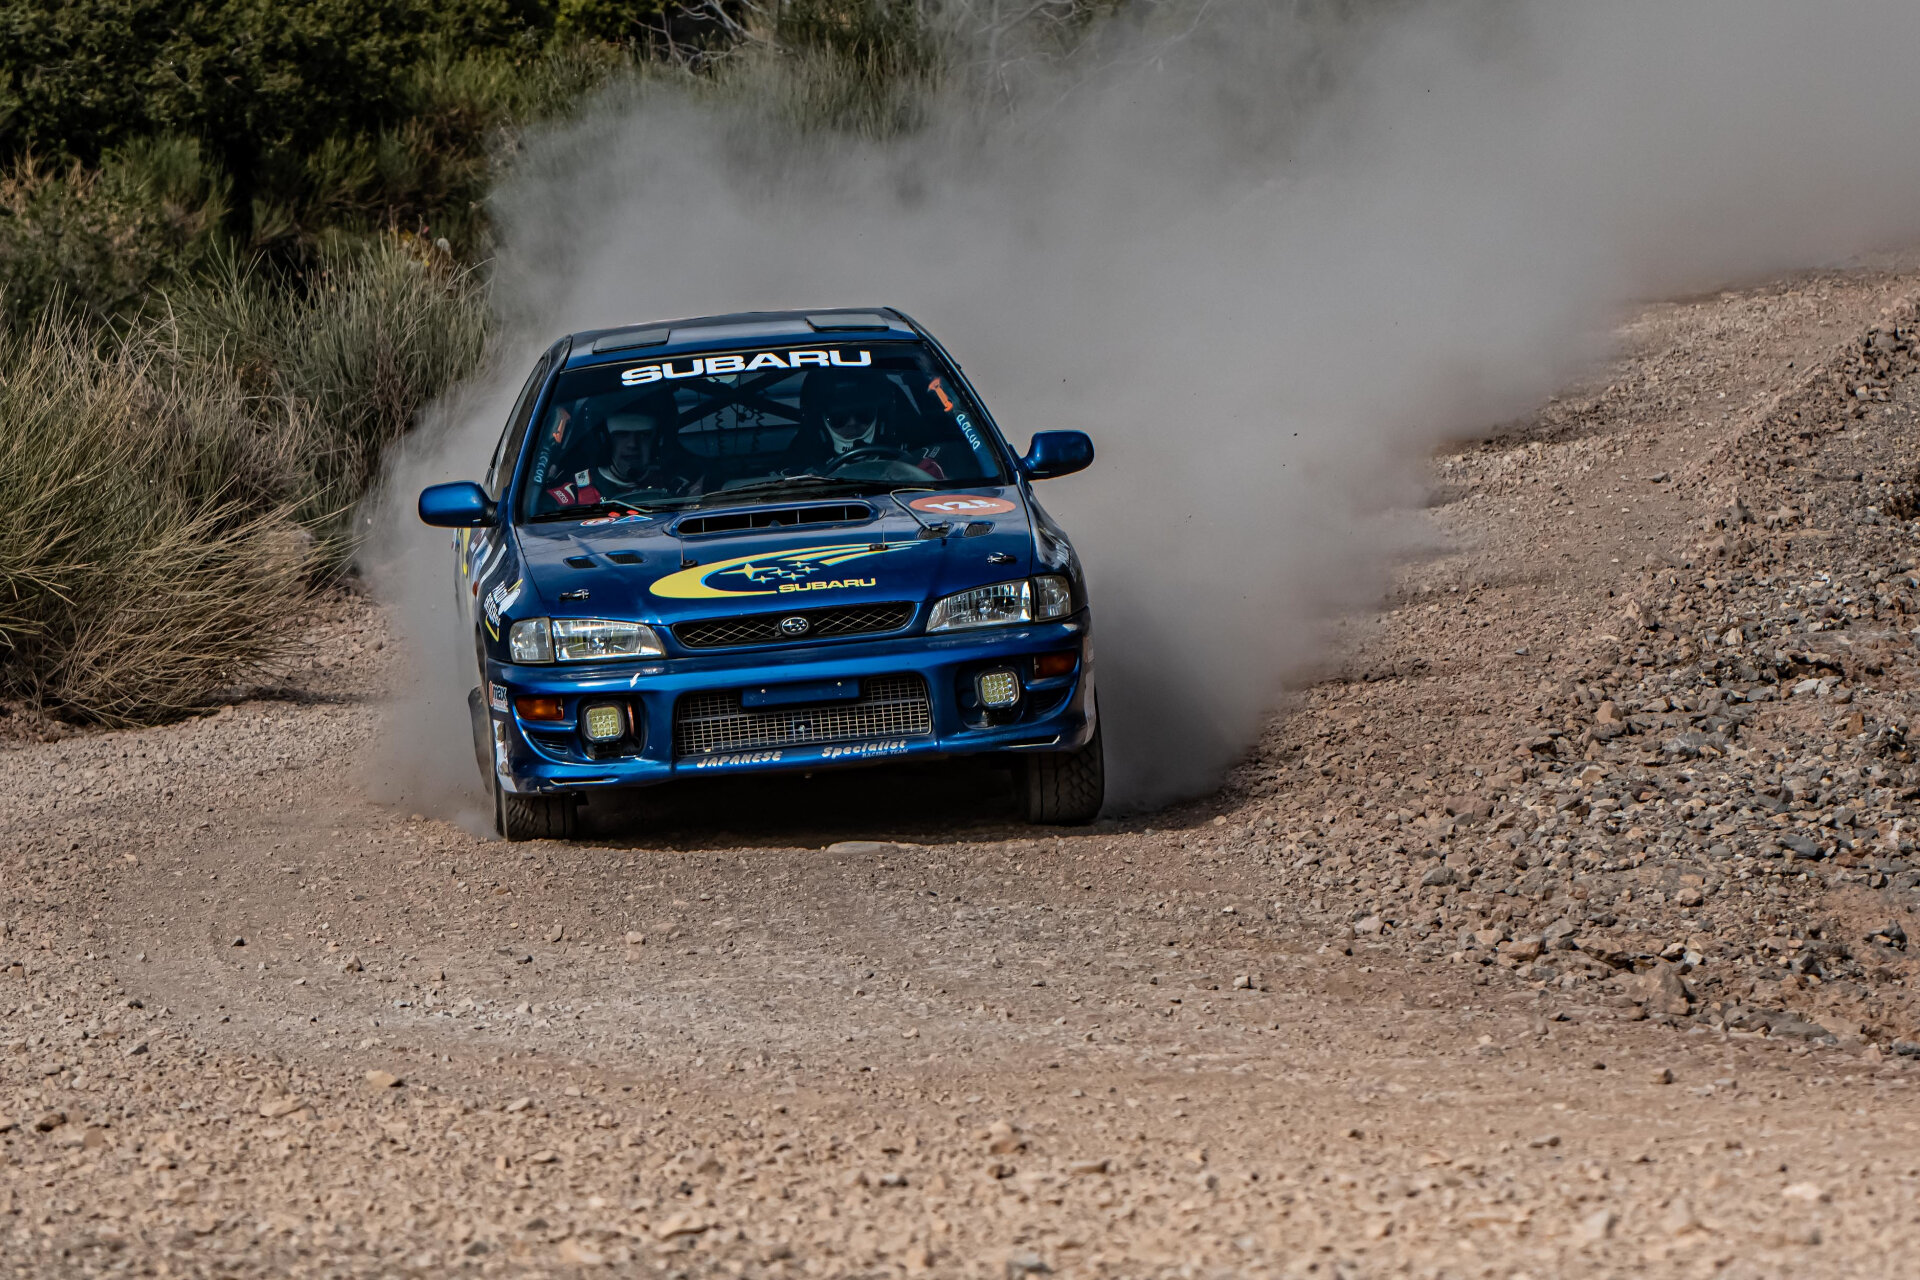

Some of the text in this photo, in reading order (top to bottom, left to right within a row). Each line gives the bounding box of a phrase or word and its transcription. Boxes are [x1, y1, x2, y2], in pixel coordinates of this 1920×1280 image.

[621, 350, 872, 386] SUBARU
[779, 577, 876, 593] SUBARU
[696, 739, 907, 769] JAPANESE Specialist
